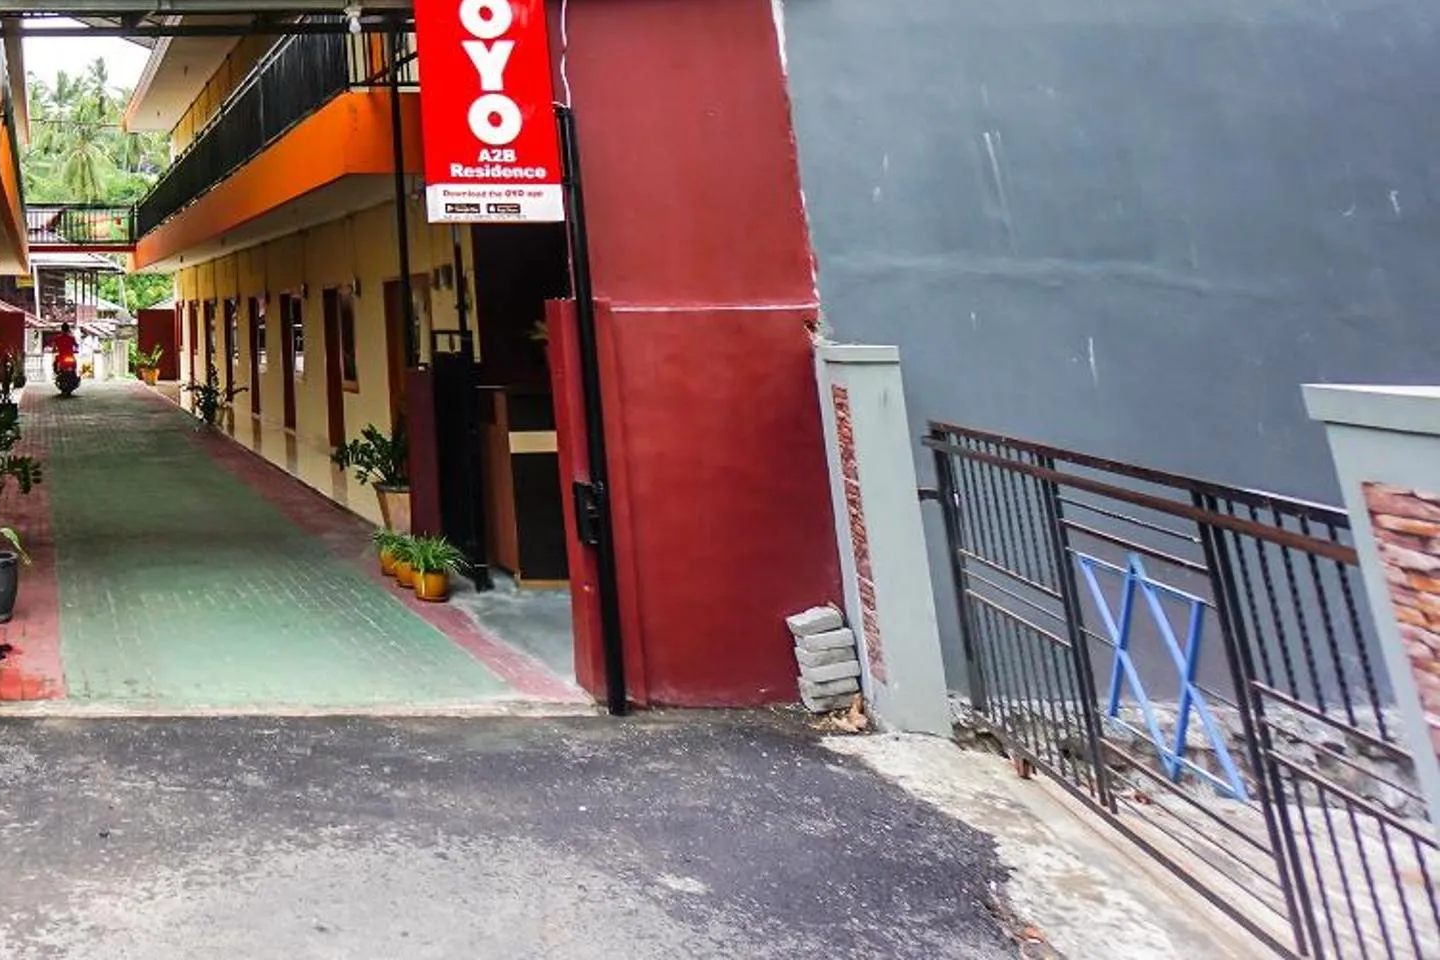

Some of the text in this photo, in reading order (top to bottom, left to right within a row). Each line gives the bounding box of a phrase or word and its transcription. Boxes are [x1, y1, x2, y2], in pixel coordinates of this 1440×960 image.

[478, 148, 516, 162] A2B
[450, 162, 546, 178] Residence
[443, 189, 486, 197] Download
[505, 189, 524, 197] OYO
